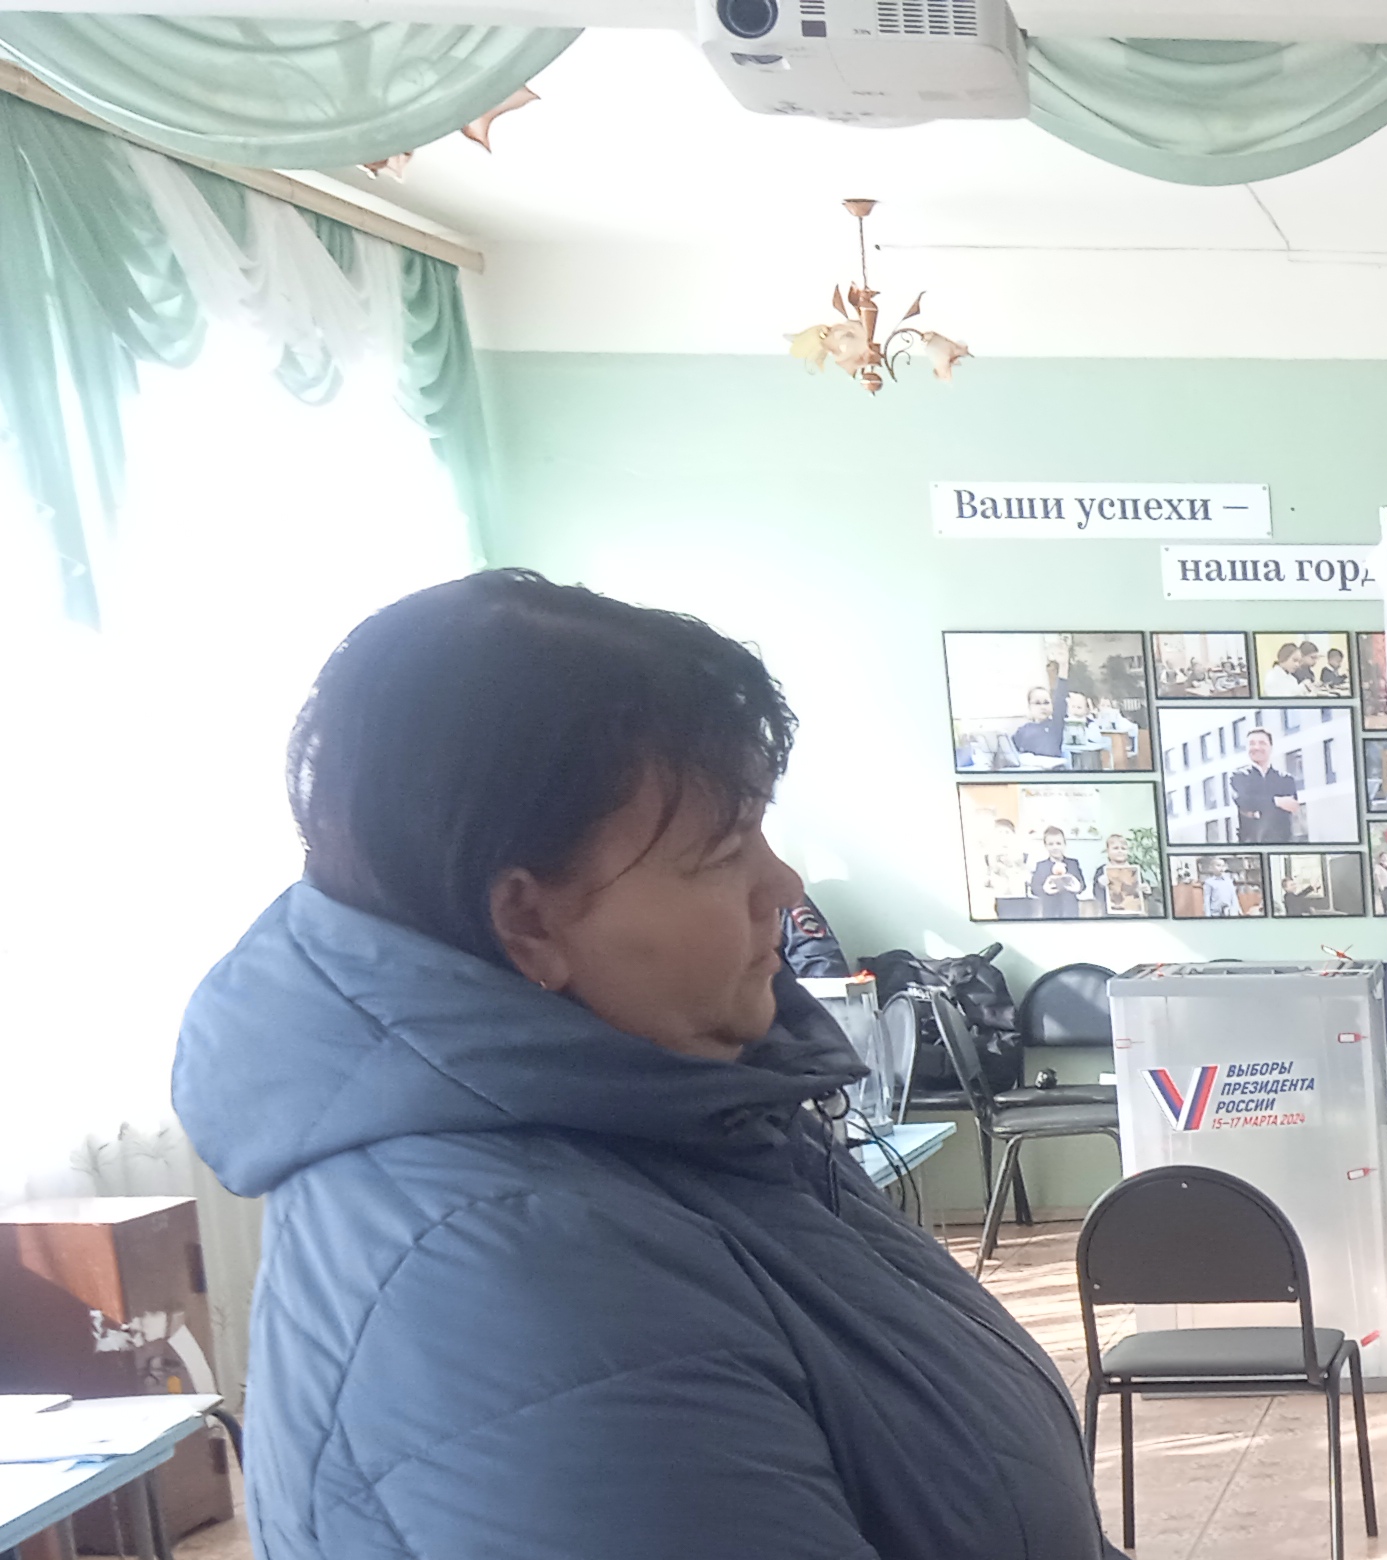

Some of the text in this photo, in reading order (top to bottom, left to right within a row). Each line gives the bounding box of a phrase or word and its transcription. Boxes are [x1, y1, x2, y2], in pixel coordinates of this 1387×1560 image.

[953, 488, 1066, 520] Ваши
[1074, 497, 1213, 530] успехи
[1177, 558, 1286, 582] наша
[1226, 1061, 1294, 1078] ВЫБОРЫ
[1220, 1078, 1315, 1096] ПРЕЗИДЕНТА
[1215, 1098, 1276, 1114] РОССИИ
[1242, 1114, 1279, 1129] МАРТА
[1279, 1112, 1306, 1126] 2024
